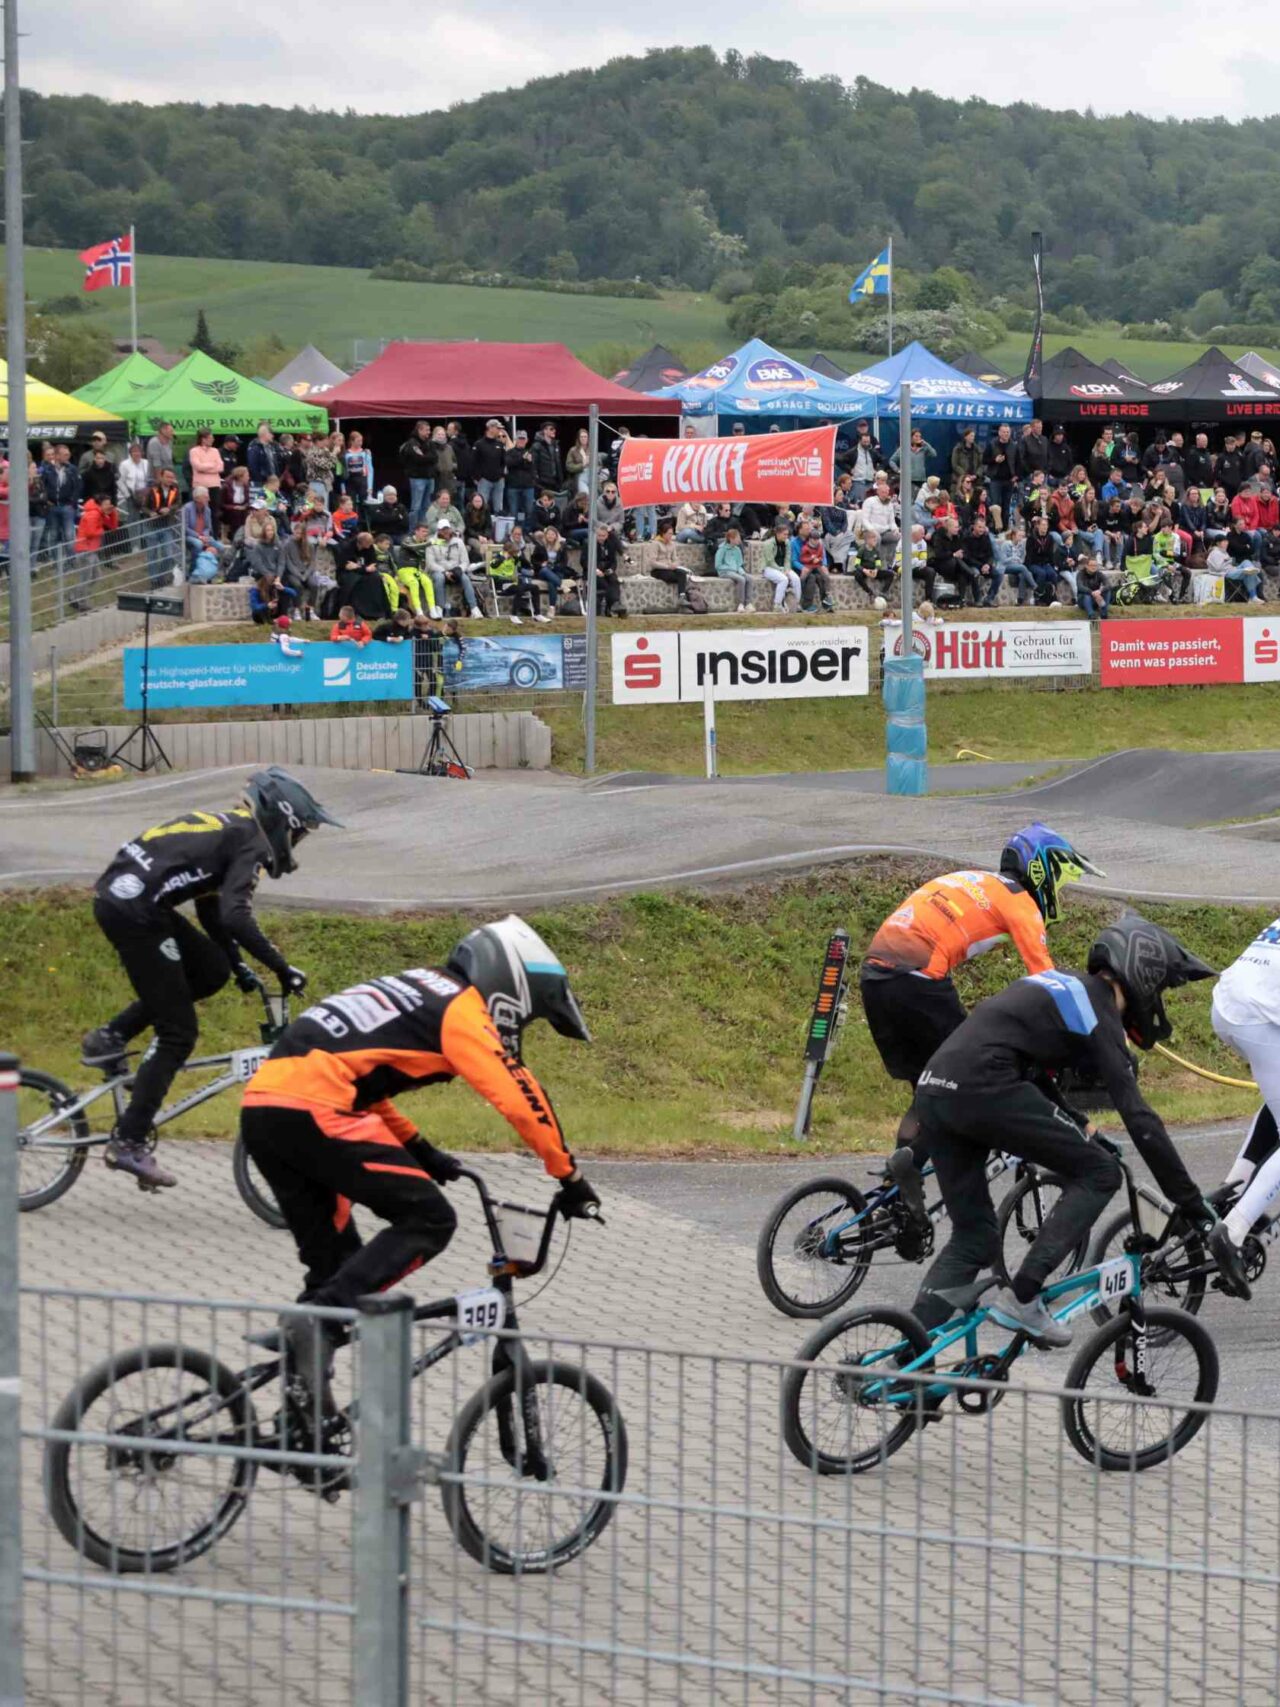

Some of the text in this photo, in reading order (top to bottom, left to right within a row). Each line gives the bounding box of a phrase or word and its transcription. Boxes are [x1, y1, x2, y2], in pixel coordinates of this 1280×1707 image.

[1080, 404, 1107, 415] LIVE
[1120, 404, 1149, 415] RIDE
[1226, 403, 1253, 414] LIVE
[171, 418, 215, 429] WARP
[220, 418, 255, 427] BMX
[1013, 636, 1055, 647] Gebraut
[1110, 638, 1222, 654] Damit was passiert,
[935, 630, 1007, 670] Hütt
[1013, 649, 1079, 661] Nordhessen.
[356, 661, 398, 671] Deutsche
[1110, 654, 1218, 670] wenn was passiert.
[356, 671, 398, 681] Glasfaser
[242, 1056, 265, 1077] 30
[1105, 1270, 1127, 1295] 416
[464, 1301, 498, 1328] 399
